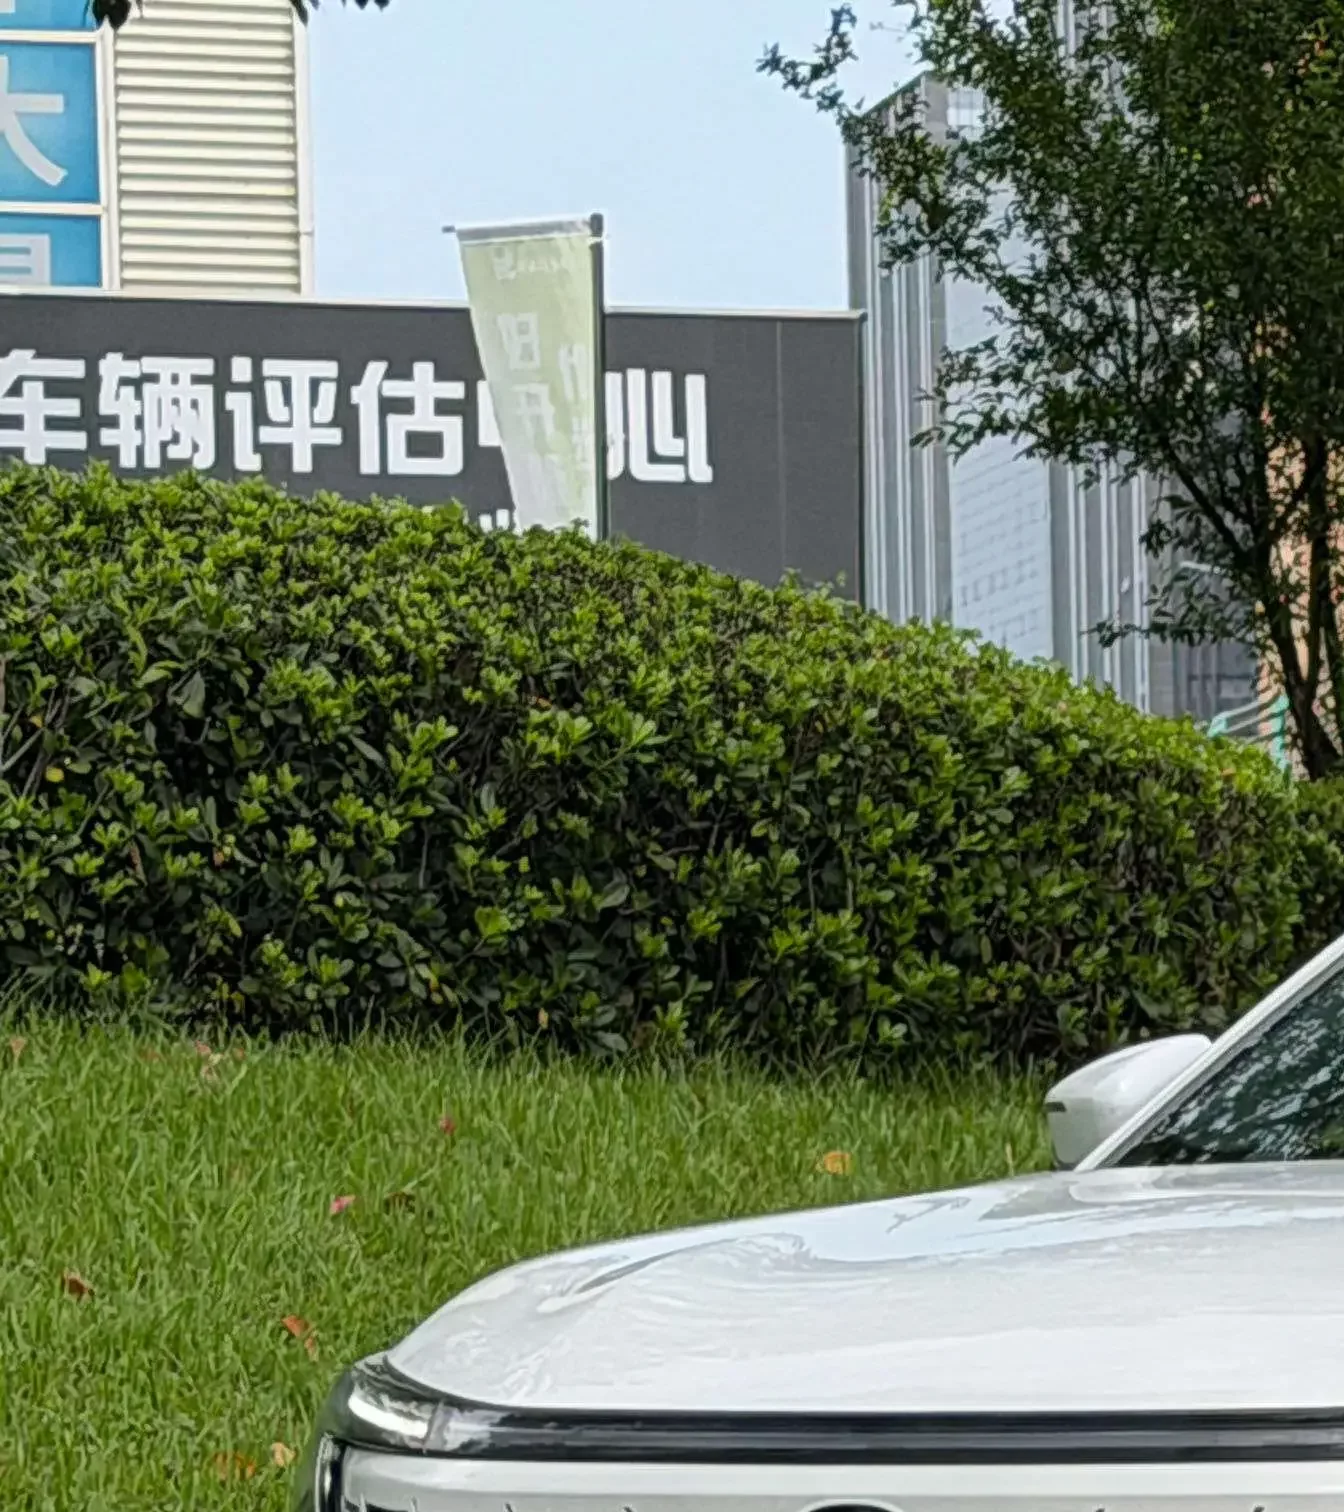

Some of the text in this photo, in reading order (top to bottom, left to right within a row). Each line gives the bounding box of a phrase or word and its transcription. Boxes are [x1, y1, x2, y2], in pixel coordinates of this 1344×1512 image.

[0, 349, 713, 482] 车辆评估心
